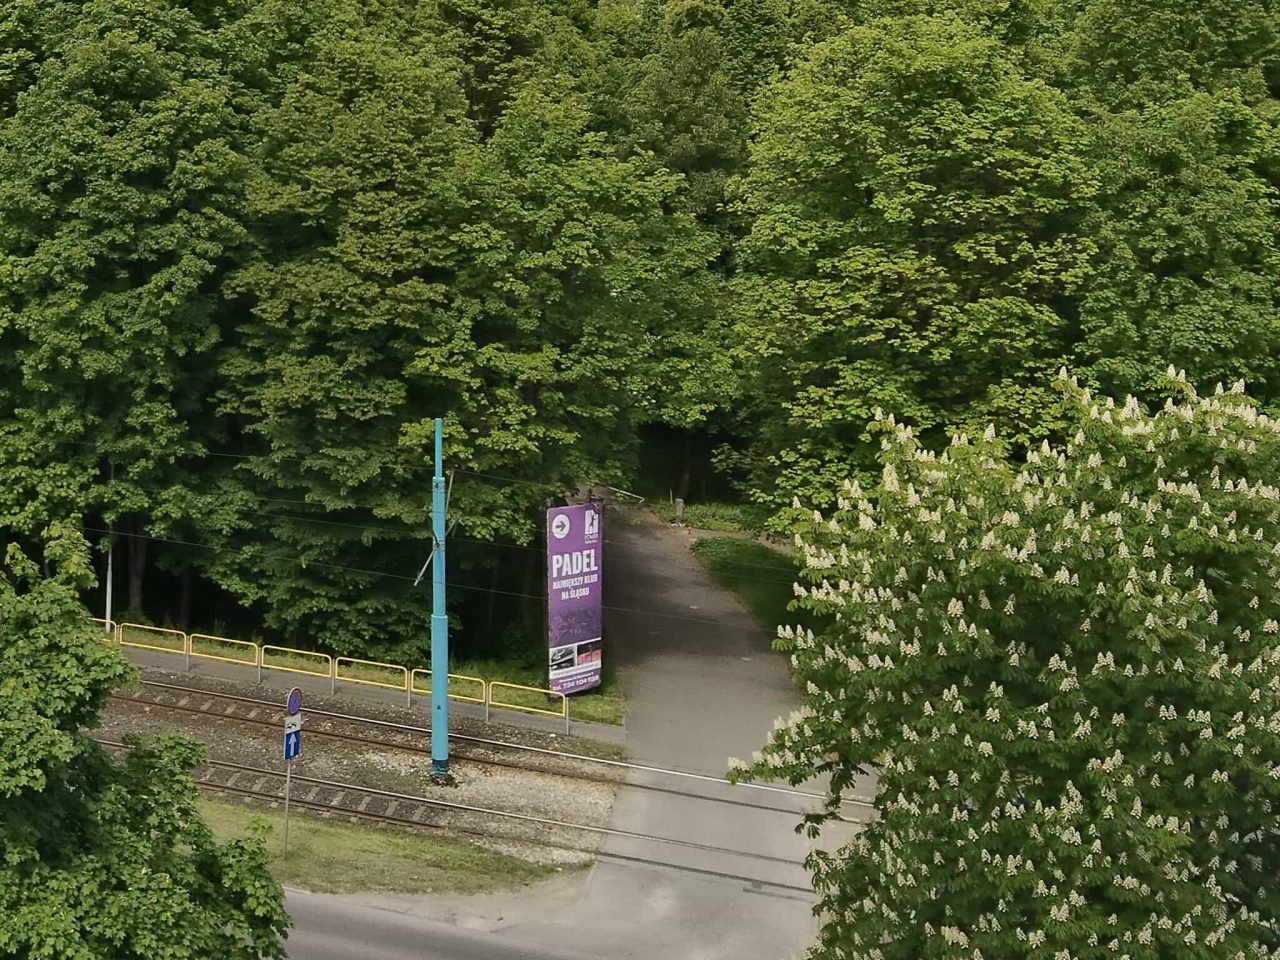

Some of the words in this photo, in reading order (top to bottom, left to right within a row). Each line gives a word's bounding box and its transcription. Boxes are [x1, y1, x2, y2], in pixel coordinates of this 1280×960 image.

[552, 549, 598, 577] PADEL
[584, 574, 598, 583] KLUB
[561, 591, 569, 600] NA
[570, 587, 589, 599] ŚLĄSKU
